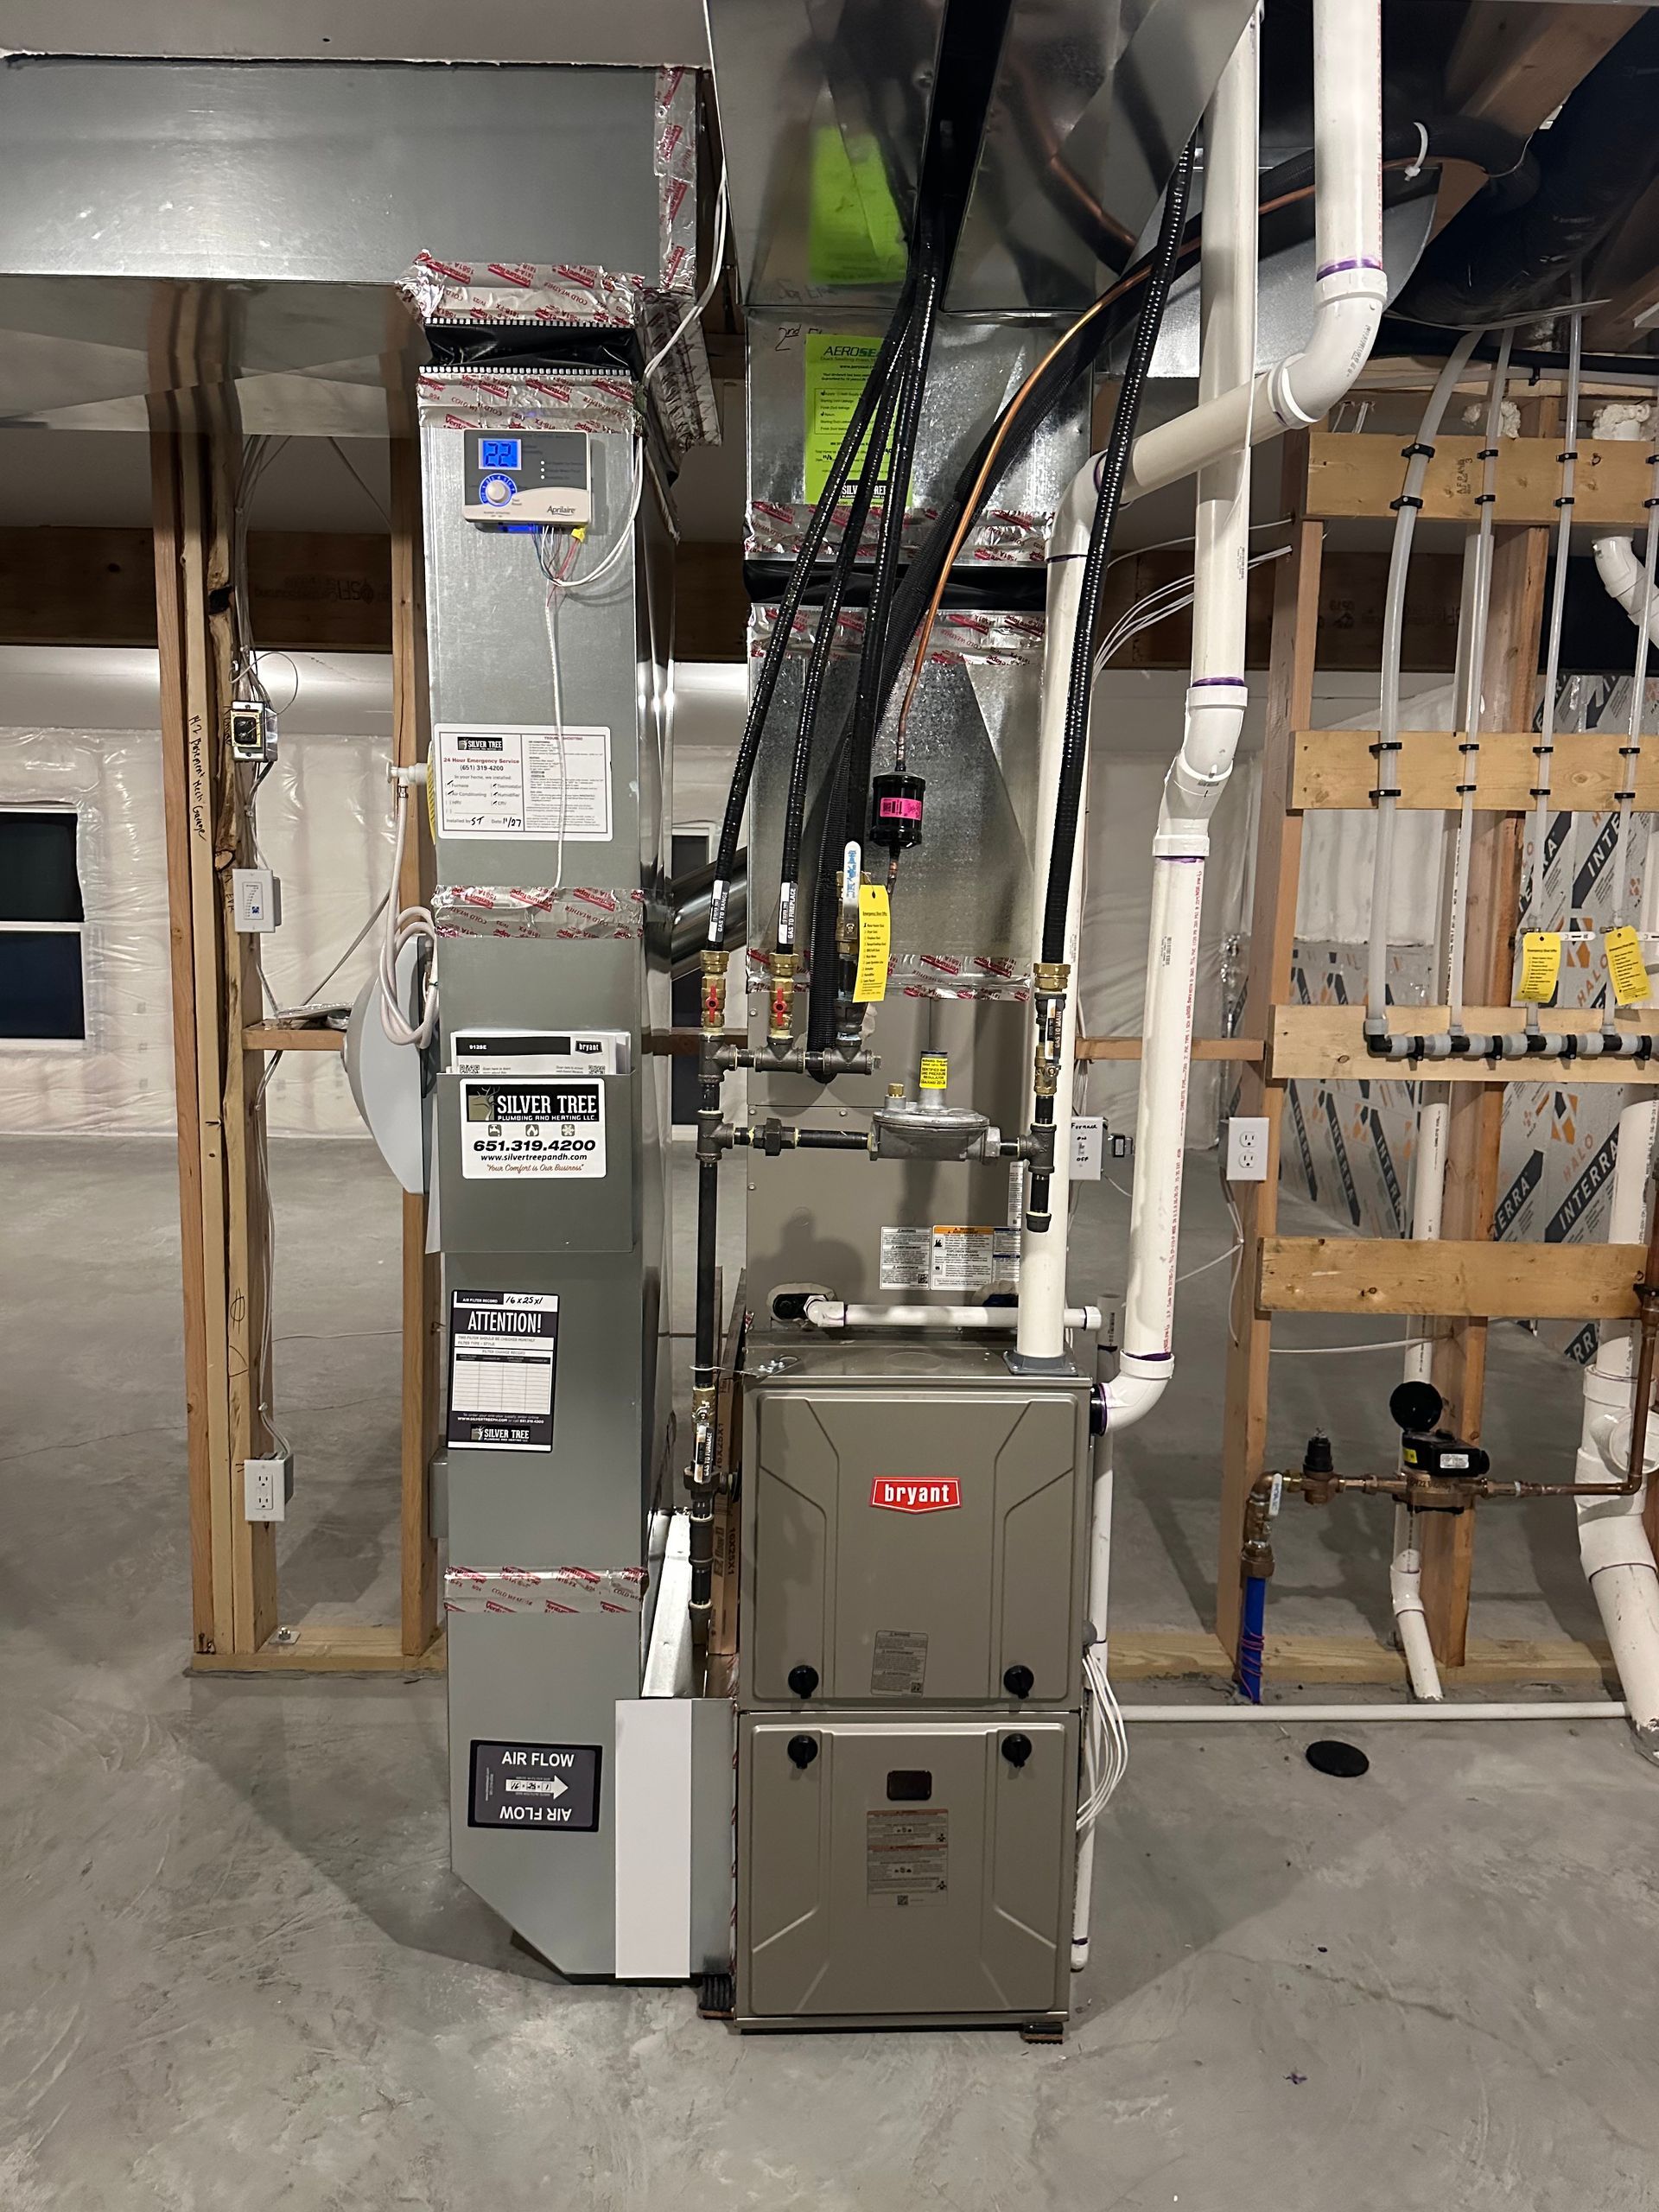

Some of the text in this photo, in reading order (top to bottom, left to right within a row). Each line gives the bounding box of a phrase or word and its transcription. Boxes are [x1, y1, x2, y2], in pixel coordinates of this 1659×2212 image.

[823, 346, 877, 357] AEROSE
[486, 442, 512, 467] 22
[842, 485, 858, 494] SILV
[547, 505, 575, 516] Aprilaire
[497, 1095, 597, 1114] SILVER TREE
[473, 1140, 595, 1152] 651.319.4200
[480, 1154, 588, 1162] www.silvertreepandh.com
[505, 1164, 531, 1174] Comfort
[1559, 1139, 1618, 1230] INTERRA
[467, 1312, 542, 1333] ATTENTION!
[484, 1429, 529, 1439] SILVER TREE
[884, 1484, 950, 1505] bryant
[728, 1528, 736, 1575] 16X25X1
[501, 1751, 574, 1767] AIR FLOW
[499, 1806, 572, 1821] AIR FLOW
